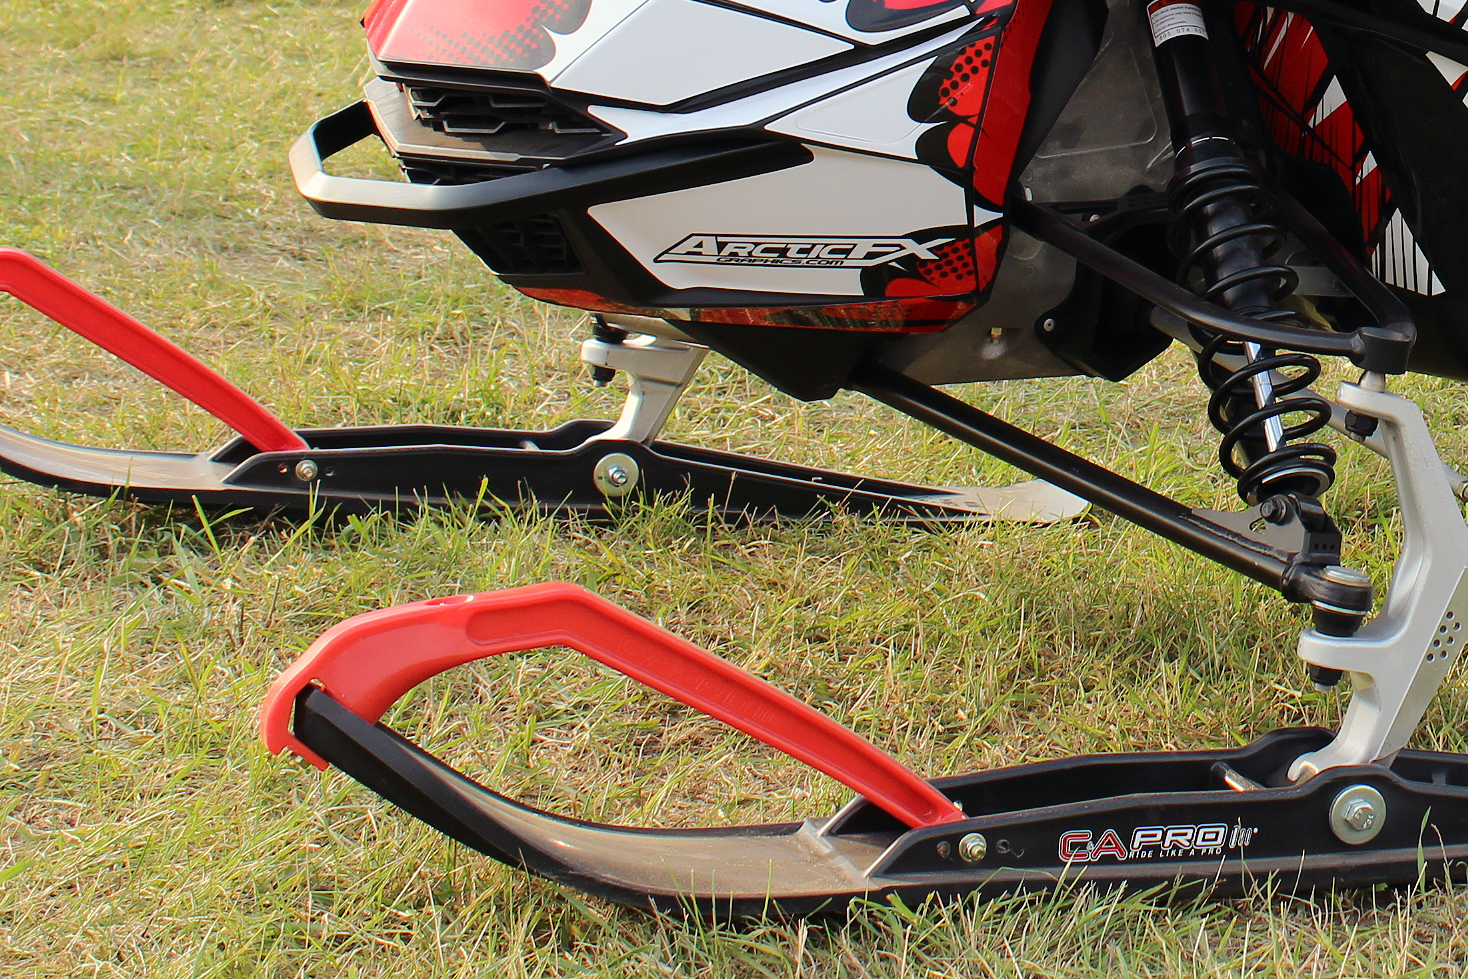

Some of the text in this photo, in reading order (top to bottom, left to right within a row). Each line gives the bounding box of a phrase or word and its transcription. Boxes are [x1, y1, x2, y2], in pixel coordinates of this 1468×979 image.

[667, 234, 957, 261] ARCTICFX
[716, 256, 845, 267] GRAPHICS.COM
[1130, 823, 1228, 852] PRO
[1128, 847, 1222, 859] RIDE LIKE A PRO
